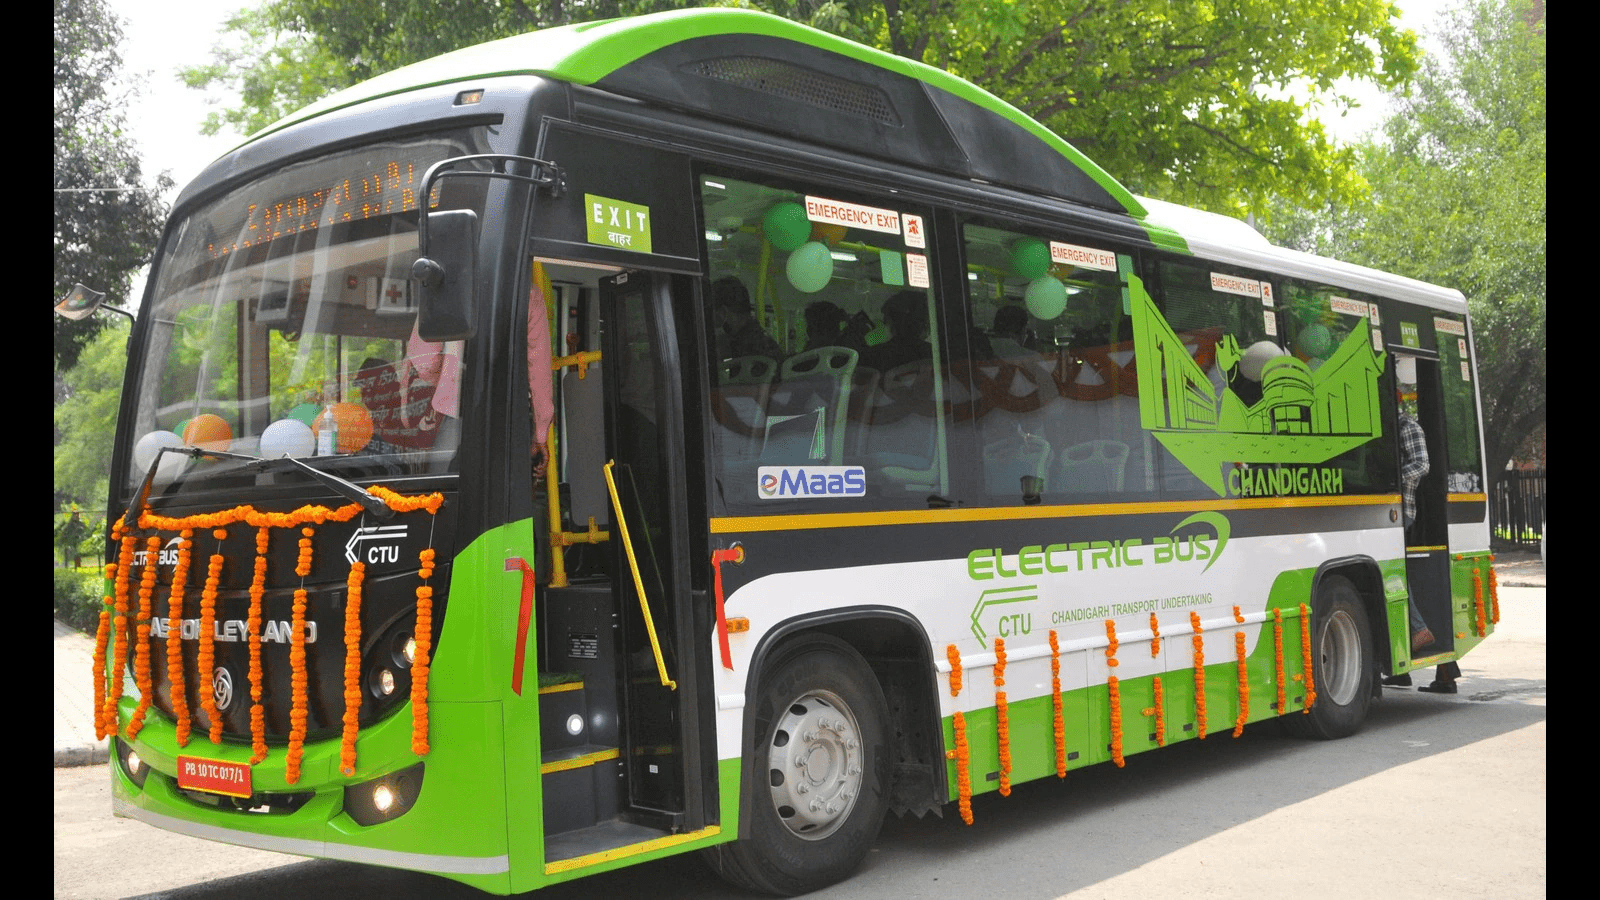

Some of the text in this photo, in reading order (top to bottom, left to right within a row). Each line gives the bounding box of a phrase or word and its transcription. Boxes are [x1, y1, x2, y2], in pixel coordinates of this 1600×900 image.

[593, 203, 645, 232] EXIT
[807, 202, 898, 229] EMERGENCY EXIT
[607, 231, 632, 247] बाहर
[1052, 246, 1115, 267] EMERGENCY EXIT
[760, 469, 865, 496] eMaaS
[1228, 467, 1344, 496] CHANDIGARH
[368, 545, 399, 564] CTU
[967, 533, 1211, 580] ELECTRIC BUS
[1051, 593, 1213, 624] CHANDIGARH TRANSPORT UNDERTAKING
[998, 613, 1031, 638] CTU
[185, 762, 244, 783] PB 10 TC 017/1
